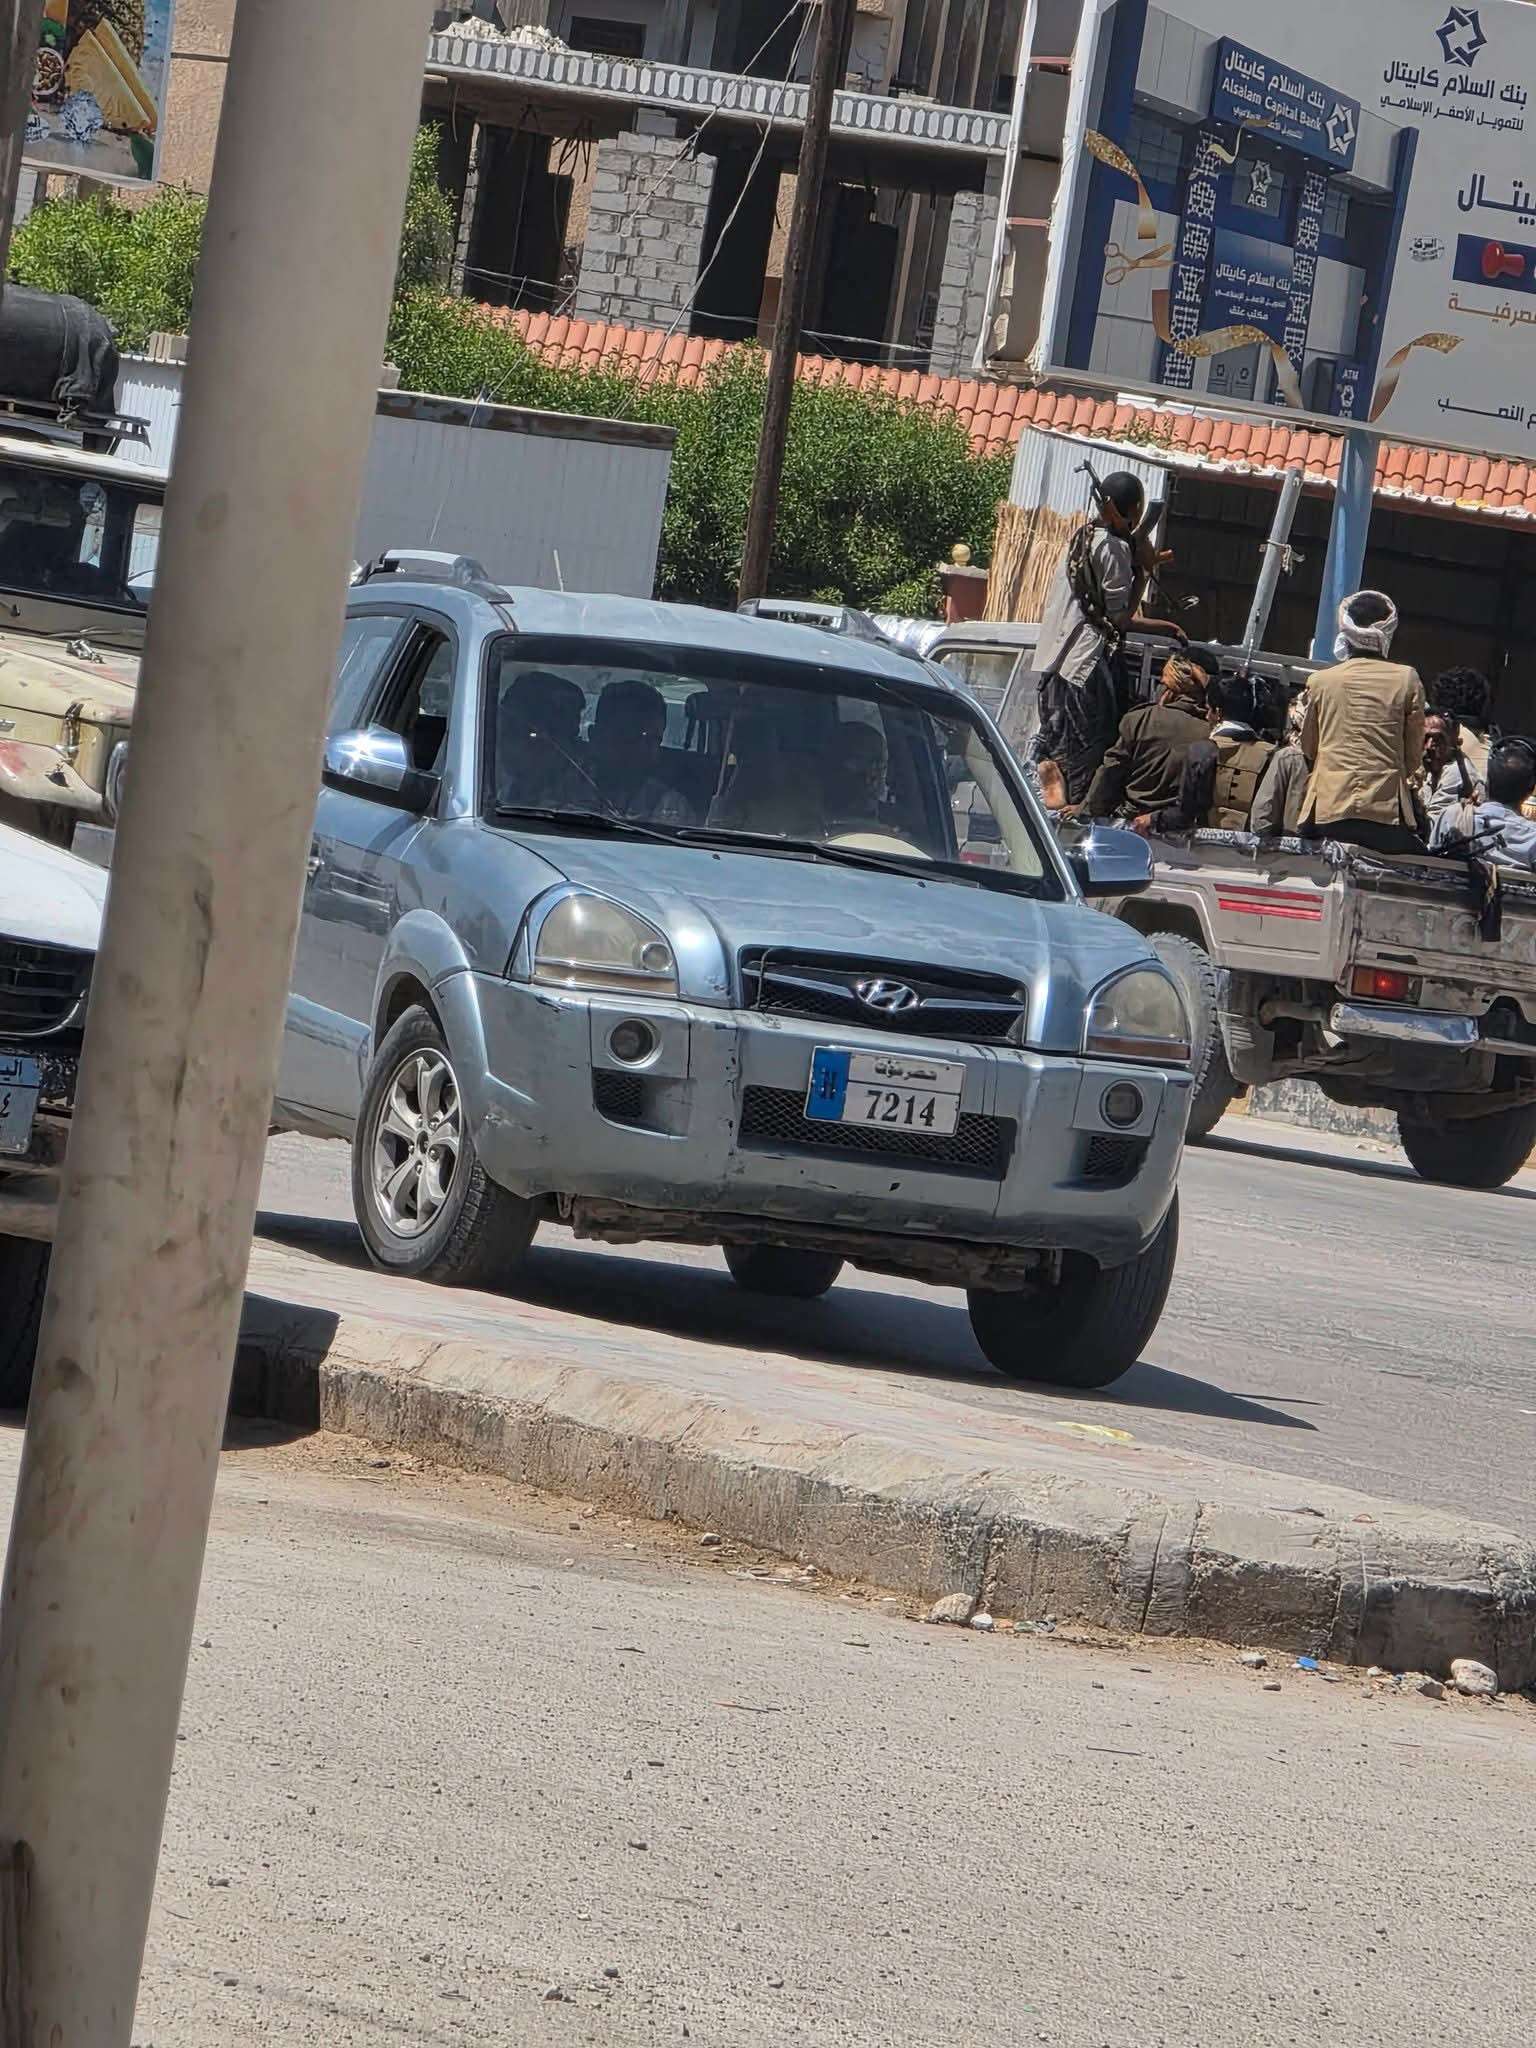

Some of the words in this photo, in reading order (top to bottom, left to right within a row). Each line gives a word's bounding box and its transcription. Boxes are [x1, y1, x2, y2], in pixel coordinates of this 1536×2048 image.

[1225, 50, 1265, 82] كابيتال
[1383, 60, 1439, 89] كابيتال
[1267, 74, 1305, 100] السلام
[1442, 74, 1496, 98] السلام
[1500, 84, 1528, 111] بنك
[1222, 77, 1262, 105] Alsalam
[1264, 96, 1299, 121] Capital
[1299, 111, 1322, 131] Bank
[1308, 90, 1326, 115] بنك
[1380, 95, 1433, 117] الإسلامي
[1476, 112, 1524, 131] للتمويل
[1248, 193, 1268, 209] ACB
[1215, 263, 1247, 281] كابيتال
[1247, 271, 1275, 288] السلام
[864, 1089, 936, 1127] 7214
